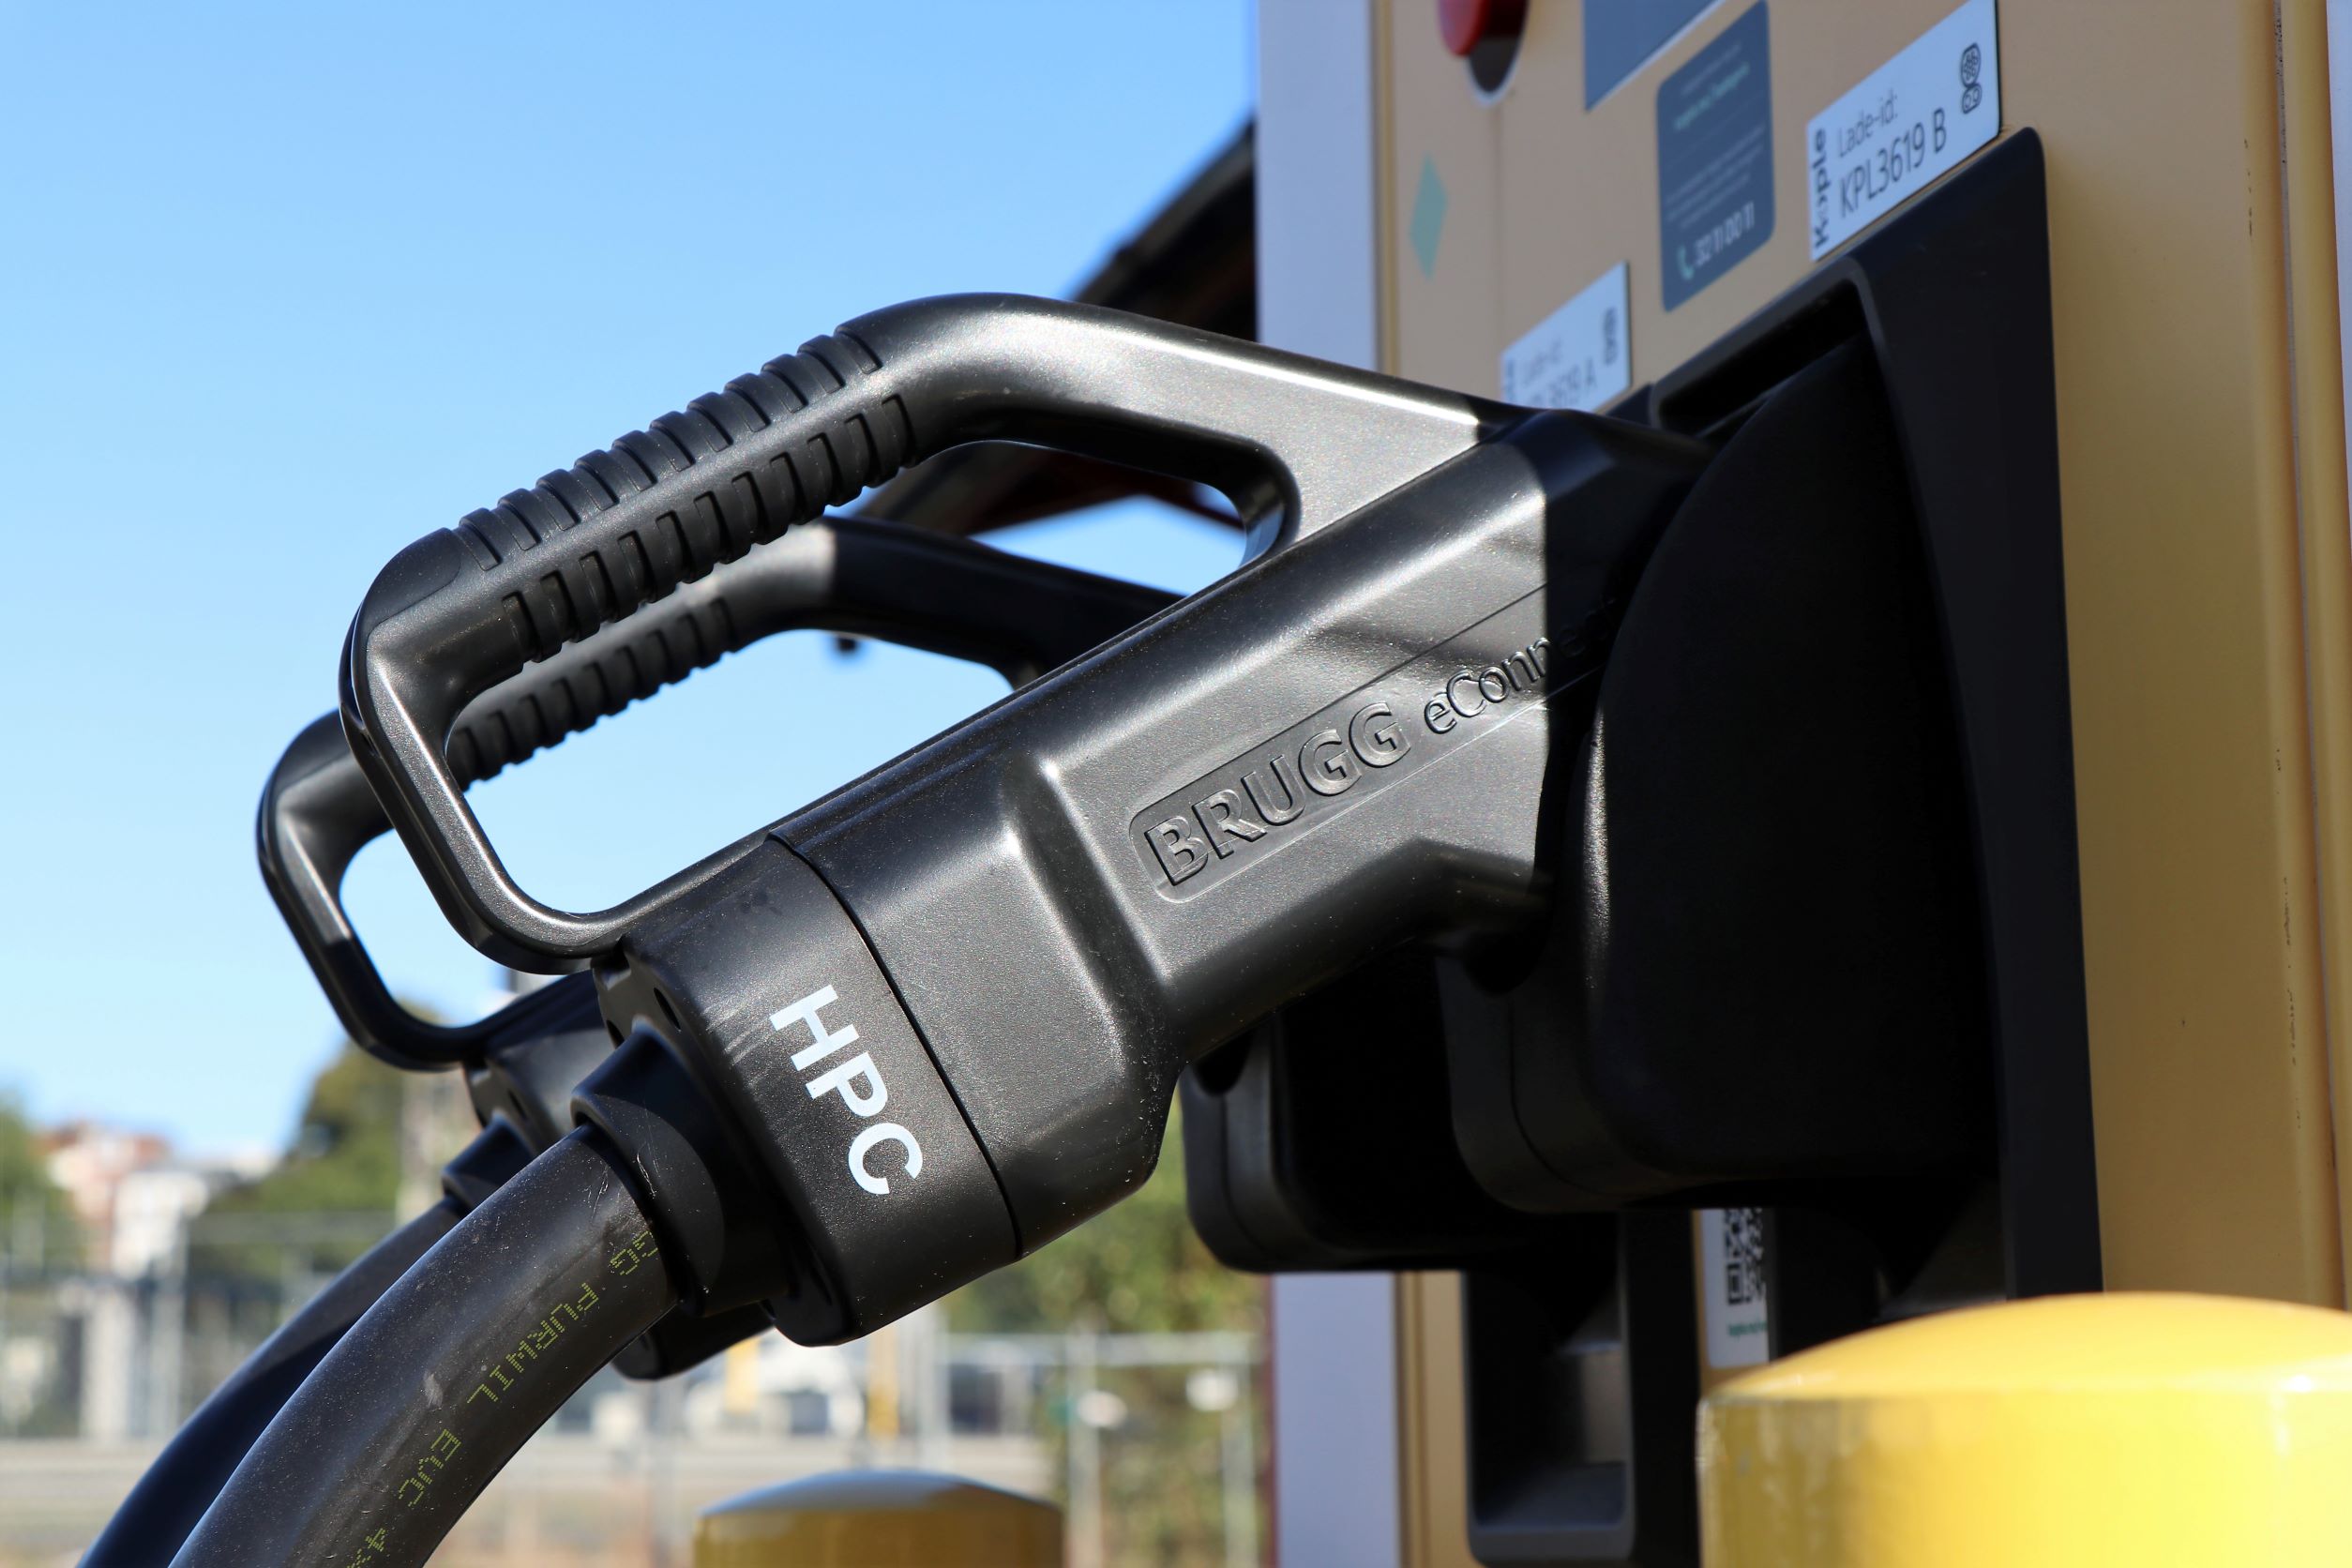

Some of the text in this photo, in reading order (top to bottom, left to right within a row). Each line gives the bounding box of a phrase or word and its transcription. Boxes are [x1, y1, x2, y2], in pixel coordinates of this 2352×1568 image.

[1838, 89, 1898, 158] Lade-id:
[1839, 122, 1925, 219] KPL3619
[1933, 107, 1947, 155] B
[1144, 701, 1411, 885] BRUGG
[769, 985, 924, 1195] HPC
[467, 1282, 600, 1404] PURWIL
[399, 1428, 461, 1507] EVC
